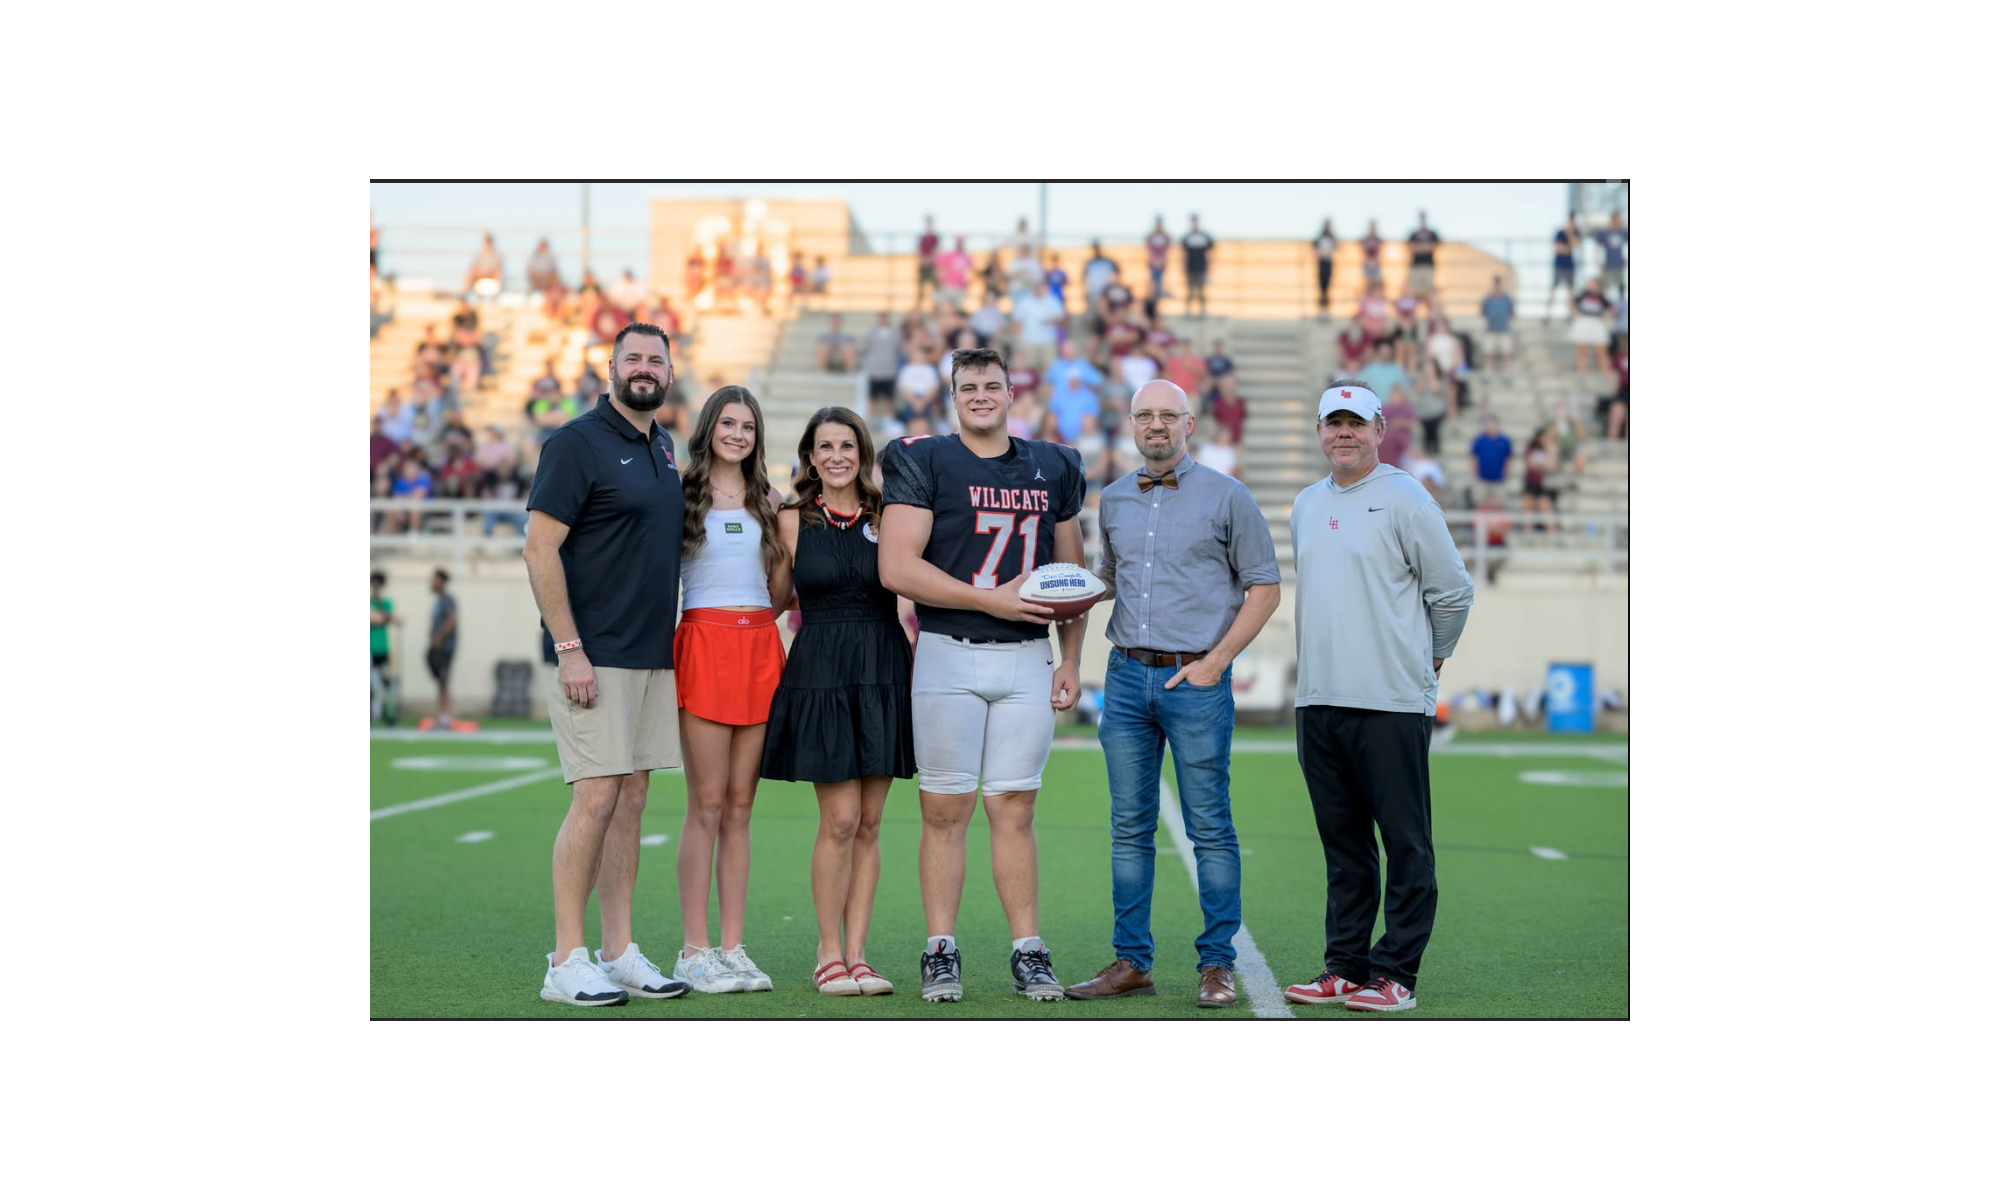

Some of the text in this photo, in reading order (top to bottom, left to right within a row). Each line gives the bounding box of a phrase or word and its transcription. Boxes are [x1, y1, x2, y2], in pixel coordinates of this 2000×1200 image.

[968, 485, 1049, 512] WILDCATS
[972, 510, 1041, 590] 71
[1040, 578, 1086, 590] UNSUNG HERO
